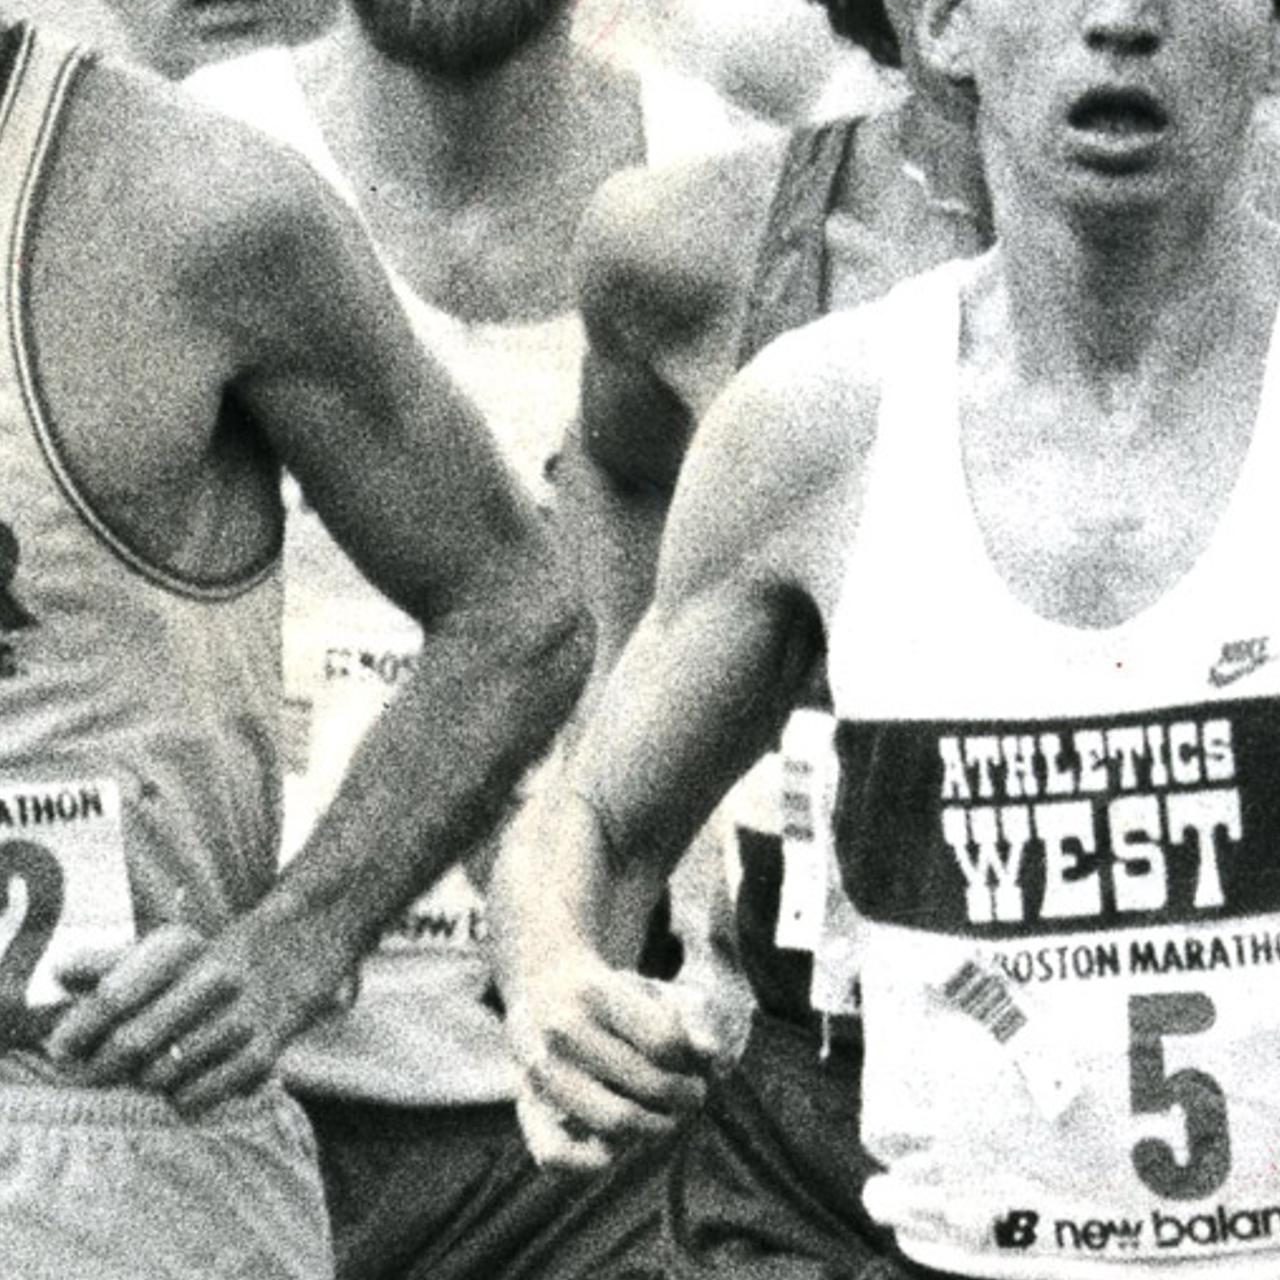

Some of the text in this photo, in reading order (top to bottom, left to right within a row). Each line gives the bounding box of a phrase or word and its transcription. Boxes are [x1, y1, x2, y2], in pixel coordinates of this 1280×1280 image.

[939, 719, 1234, 800] ATHLETICS
[941, 787, 1243, 923] WEST
[1127, 990, 1232, 1201] 5
[1053, 1218, 1144, 1250] new
